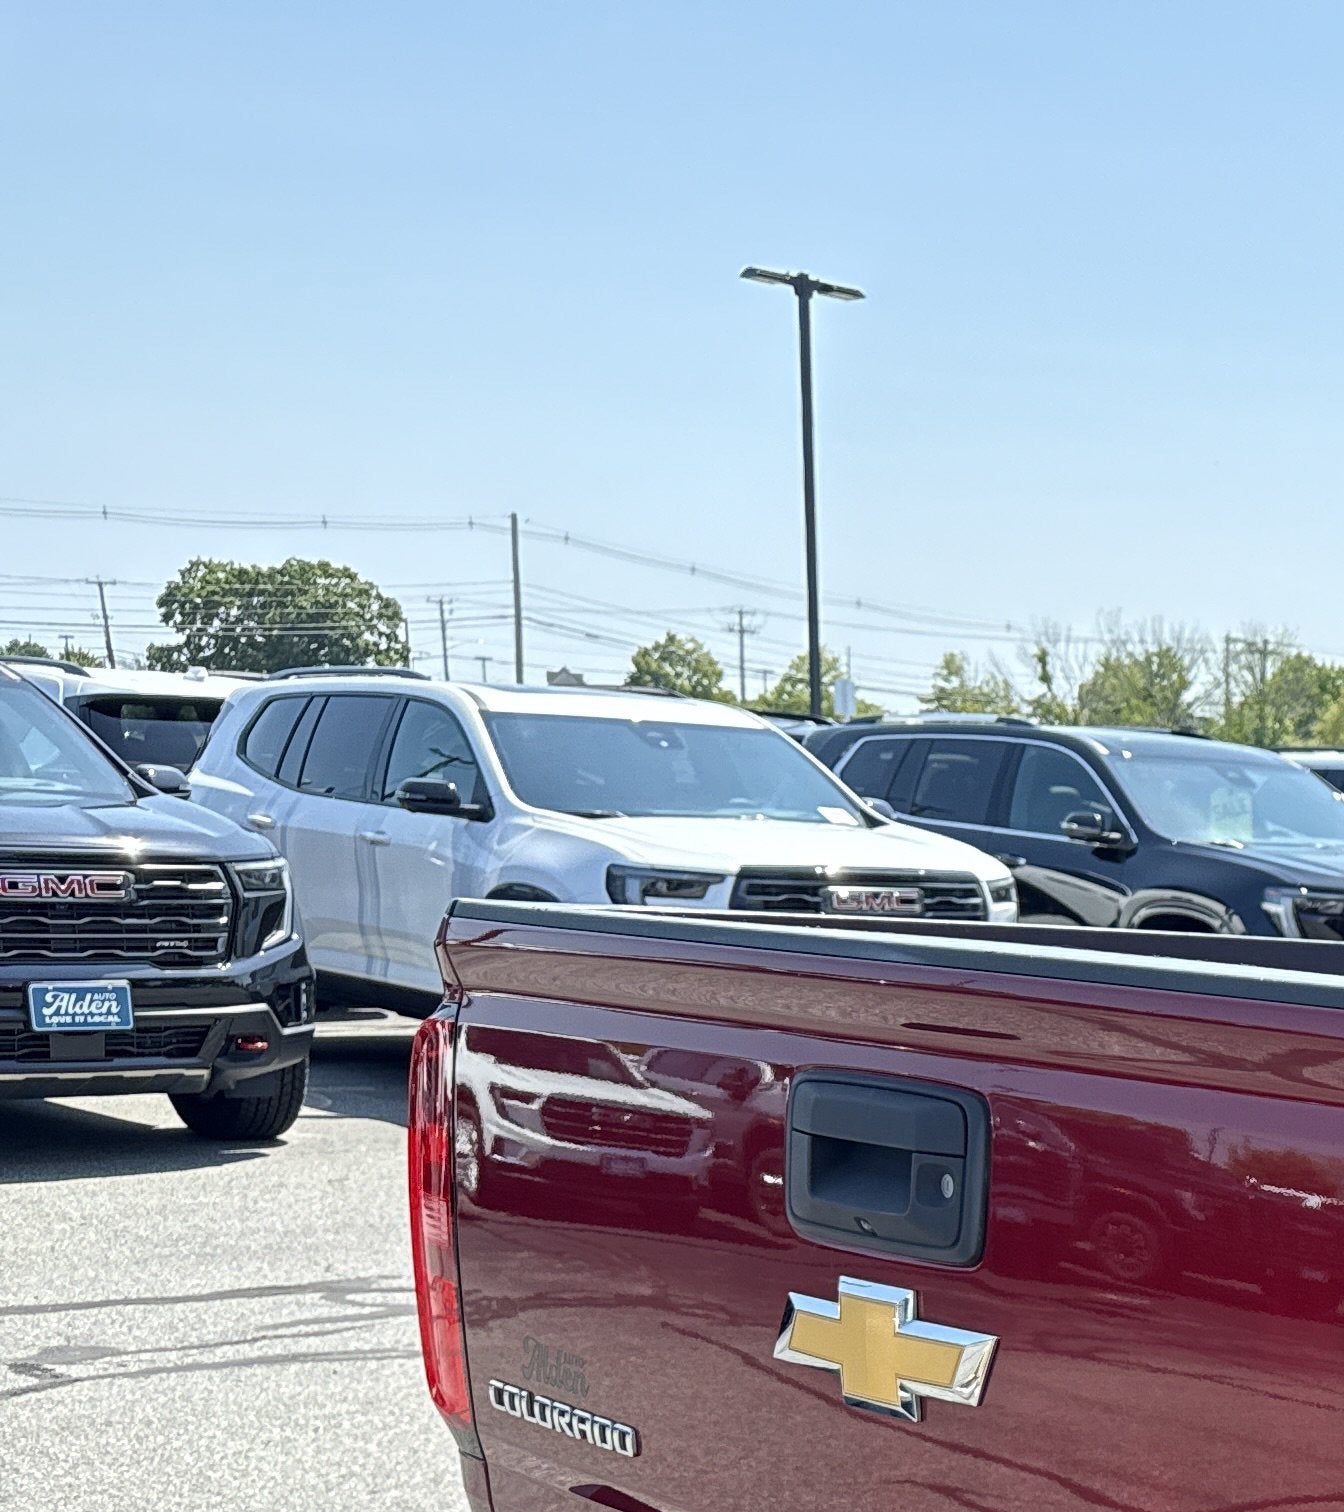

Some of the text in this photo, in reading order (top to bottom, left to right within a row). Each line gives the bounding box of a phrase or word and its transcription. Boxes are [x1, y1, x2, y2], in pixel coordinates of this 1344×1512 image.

[0, 875, 125, 897] GMC
[832, 890, 919, 912] GMC
[42, 992, 121, 1015] Alden
[93, 993, 117, 1001] AUTO
[488, 1378, 637, 1458] COLORADO
